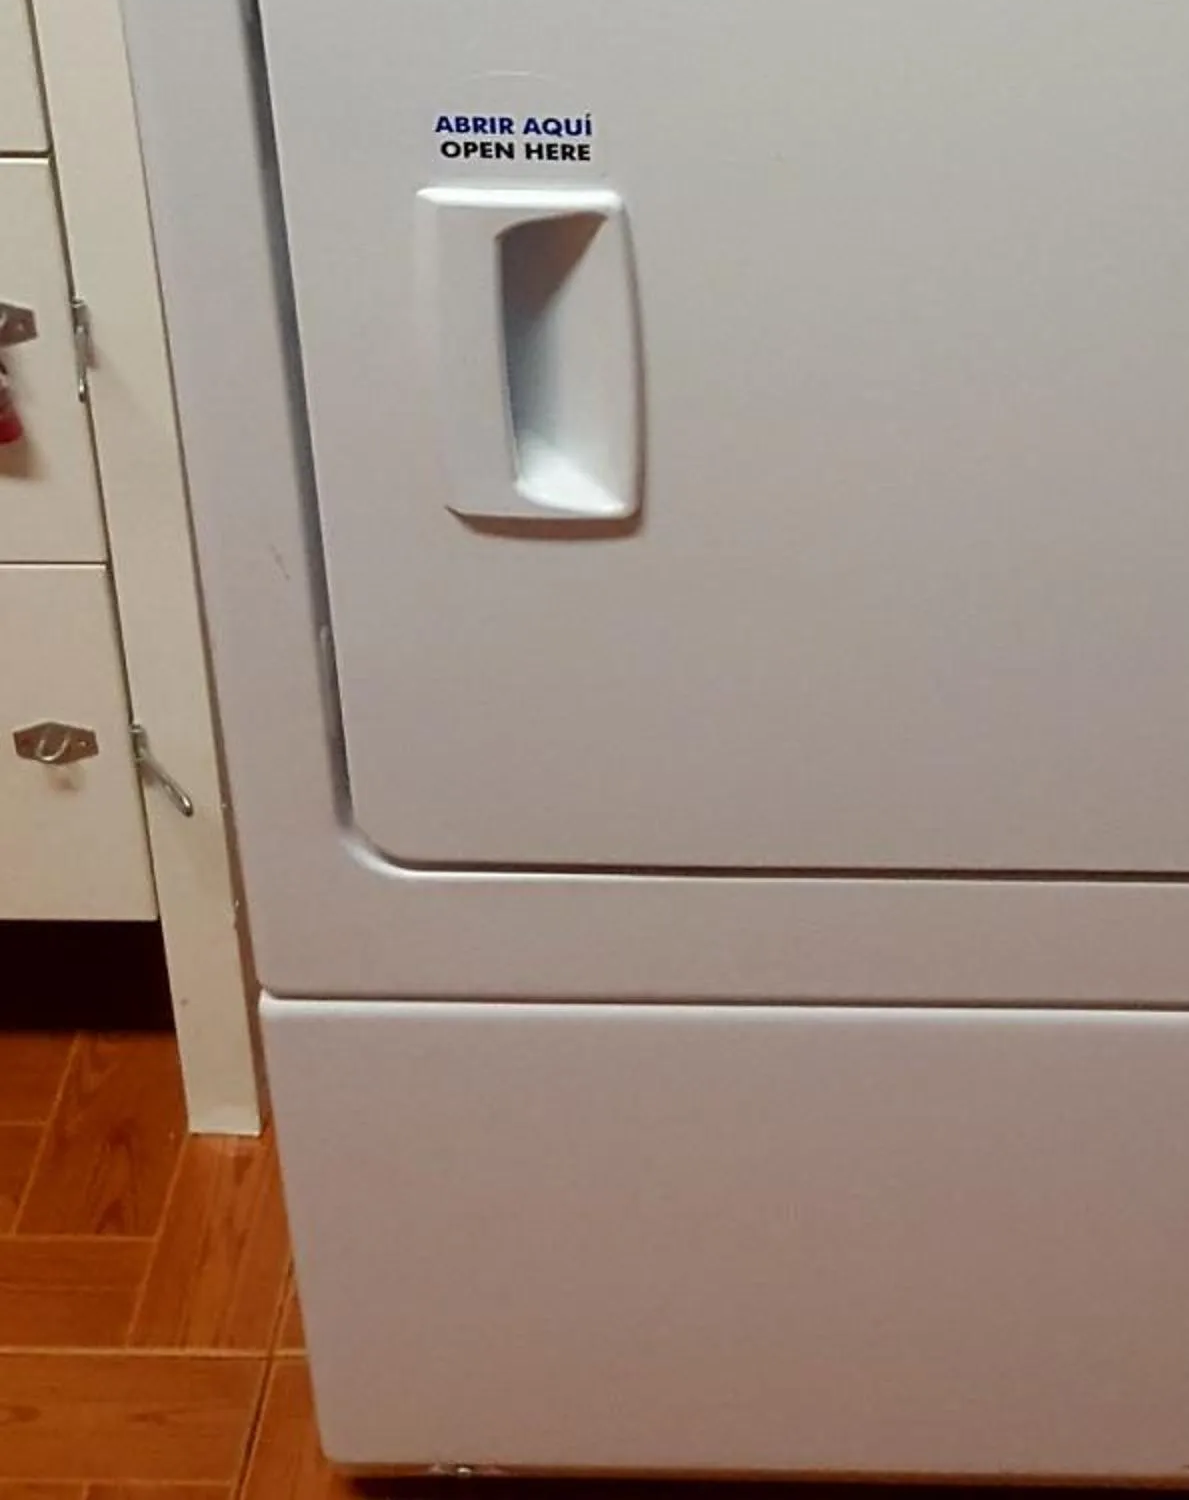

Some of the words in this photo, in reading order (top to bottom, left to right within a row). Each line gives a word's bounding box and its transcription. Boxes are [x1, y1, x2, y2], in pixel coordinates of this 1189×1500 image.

[434, 115, 515, 137] ABRIR
[522, 111, 594, 140] AQUÍ
[439, 140, 518, 161] OPEN
[524, 141, 592, 162] HERE
